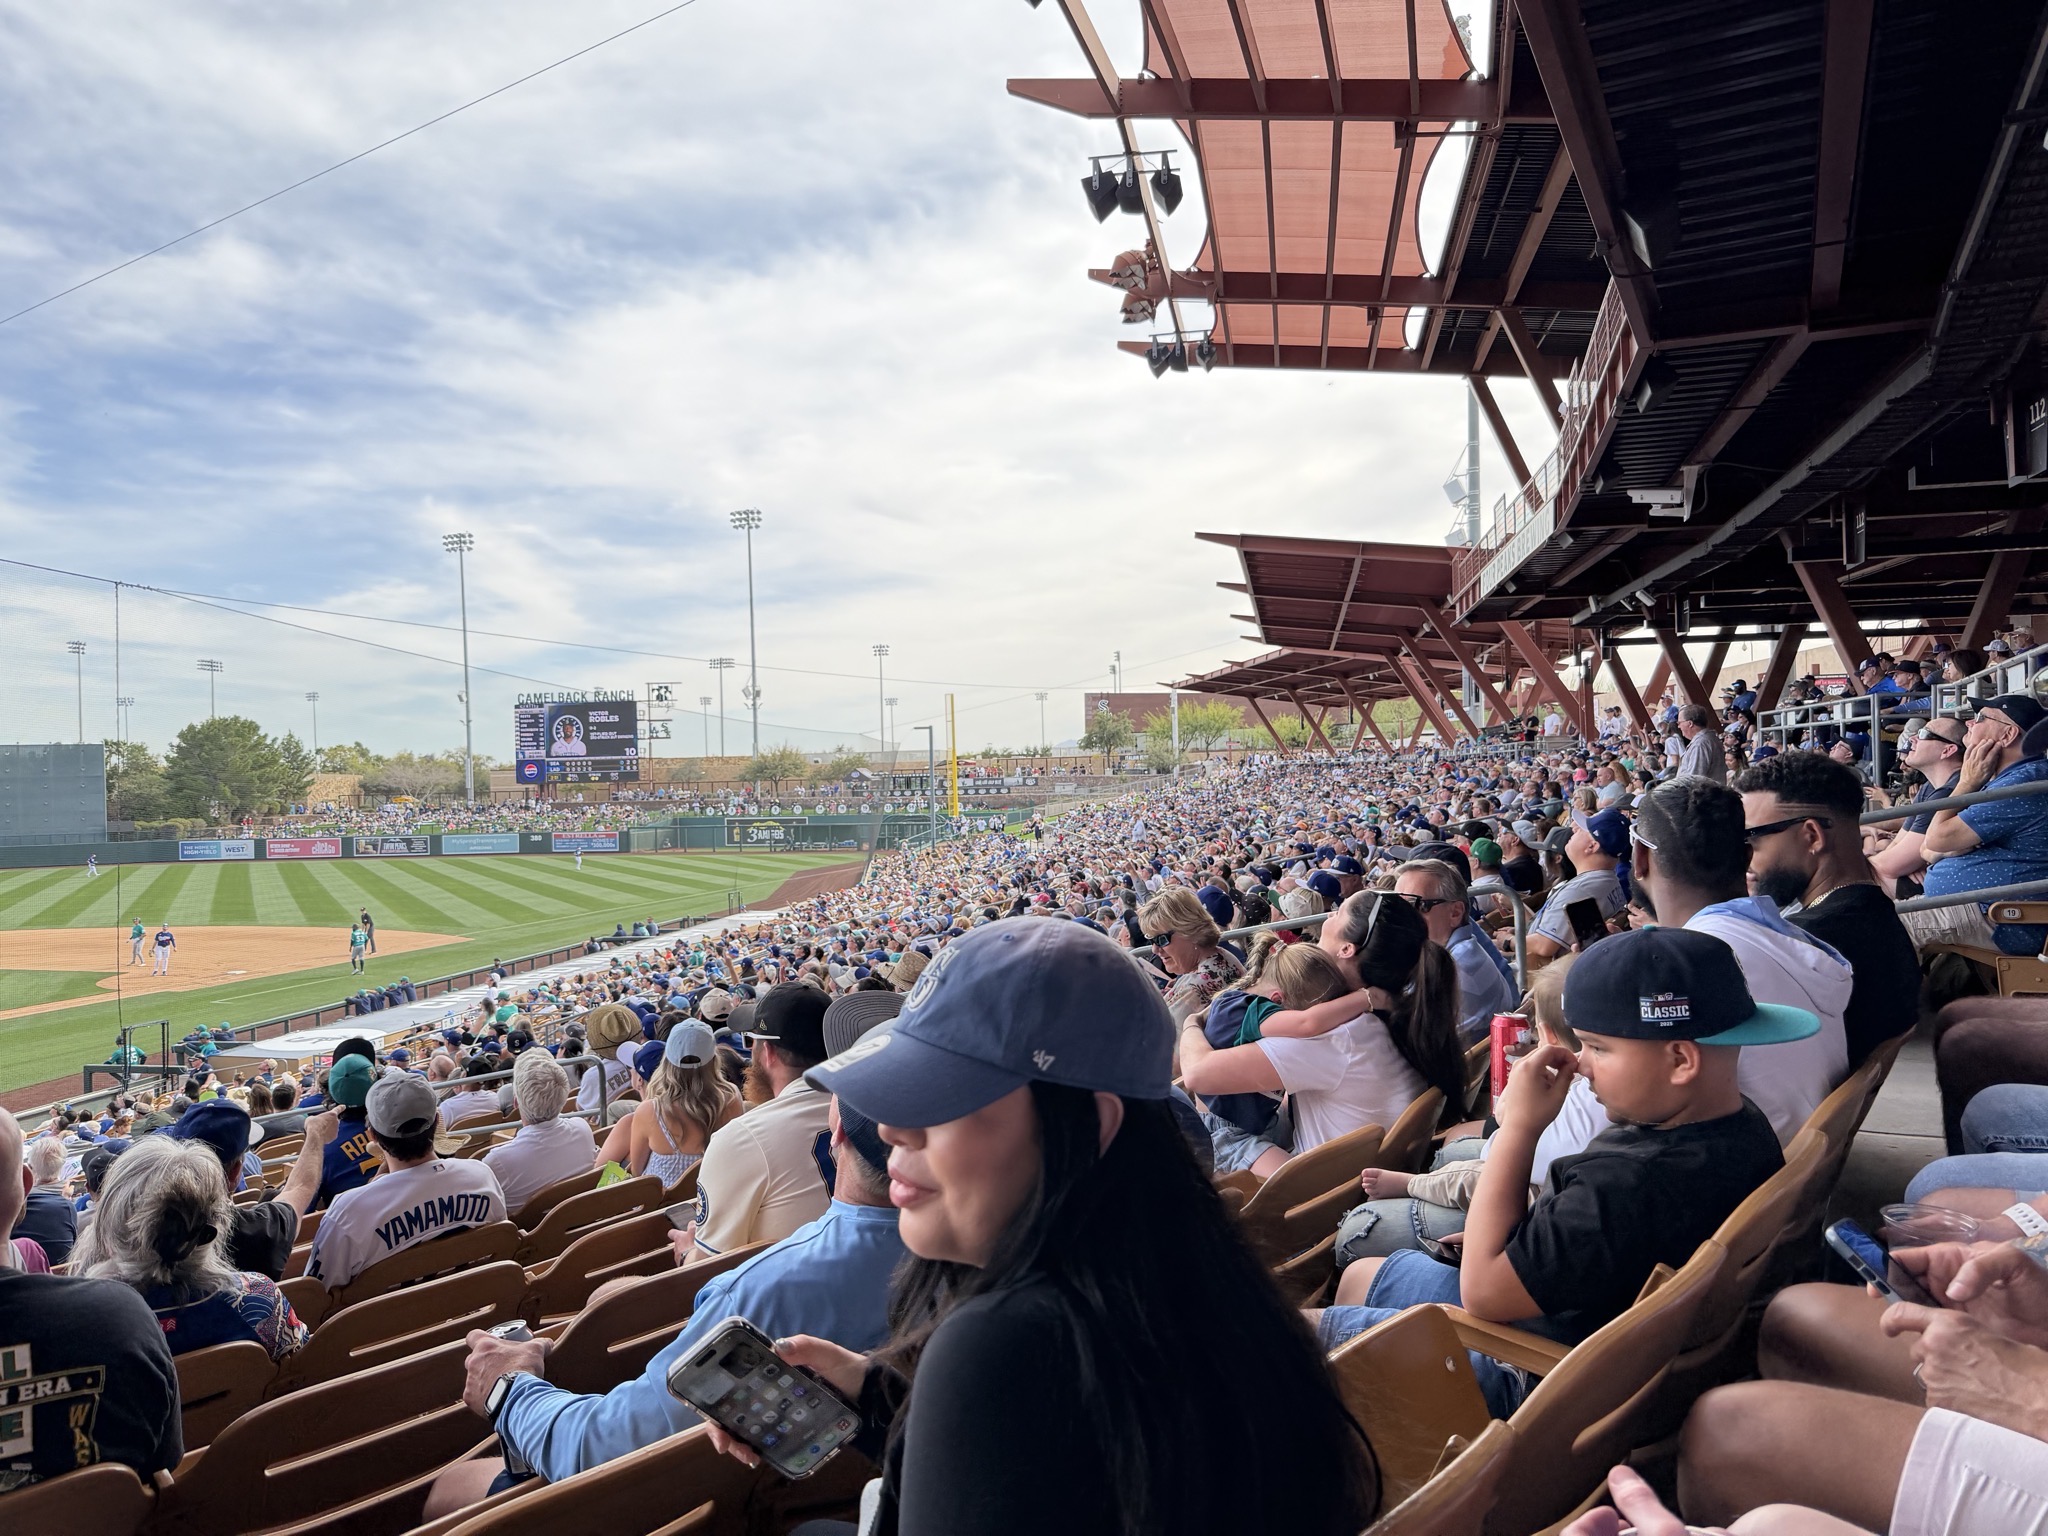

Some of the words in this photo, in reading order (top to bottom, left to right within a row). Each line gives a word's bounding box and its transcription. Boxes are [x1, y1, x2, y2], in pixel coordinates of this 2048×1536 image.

[2030, 397, 2046, 425] 112
[1856, 512, 1865, 529] 112
[517, 691, 588, 704] CAMELBACK
[594, 690, 634, 702] RANCH
[589, 715, 619, 723] ROBLES
[624, 747, 637, 756] 10
[747, 828, 757, 842] 3
[312, 840, 335, 855] CHICAGO
[2007, 909, 2016, 917] 19
[1641, 1004, 1690, 1019] CLASSIC
[375, 1193, 491, 1251] YAMAMOTO
[18, 1375, 72, 1402] ERA
